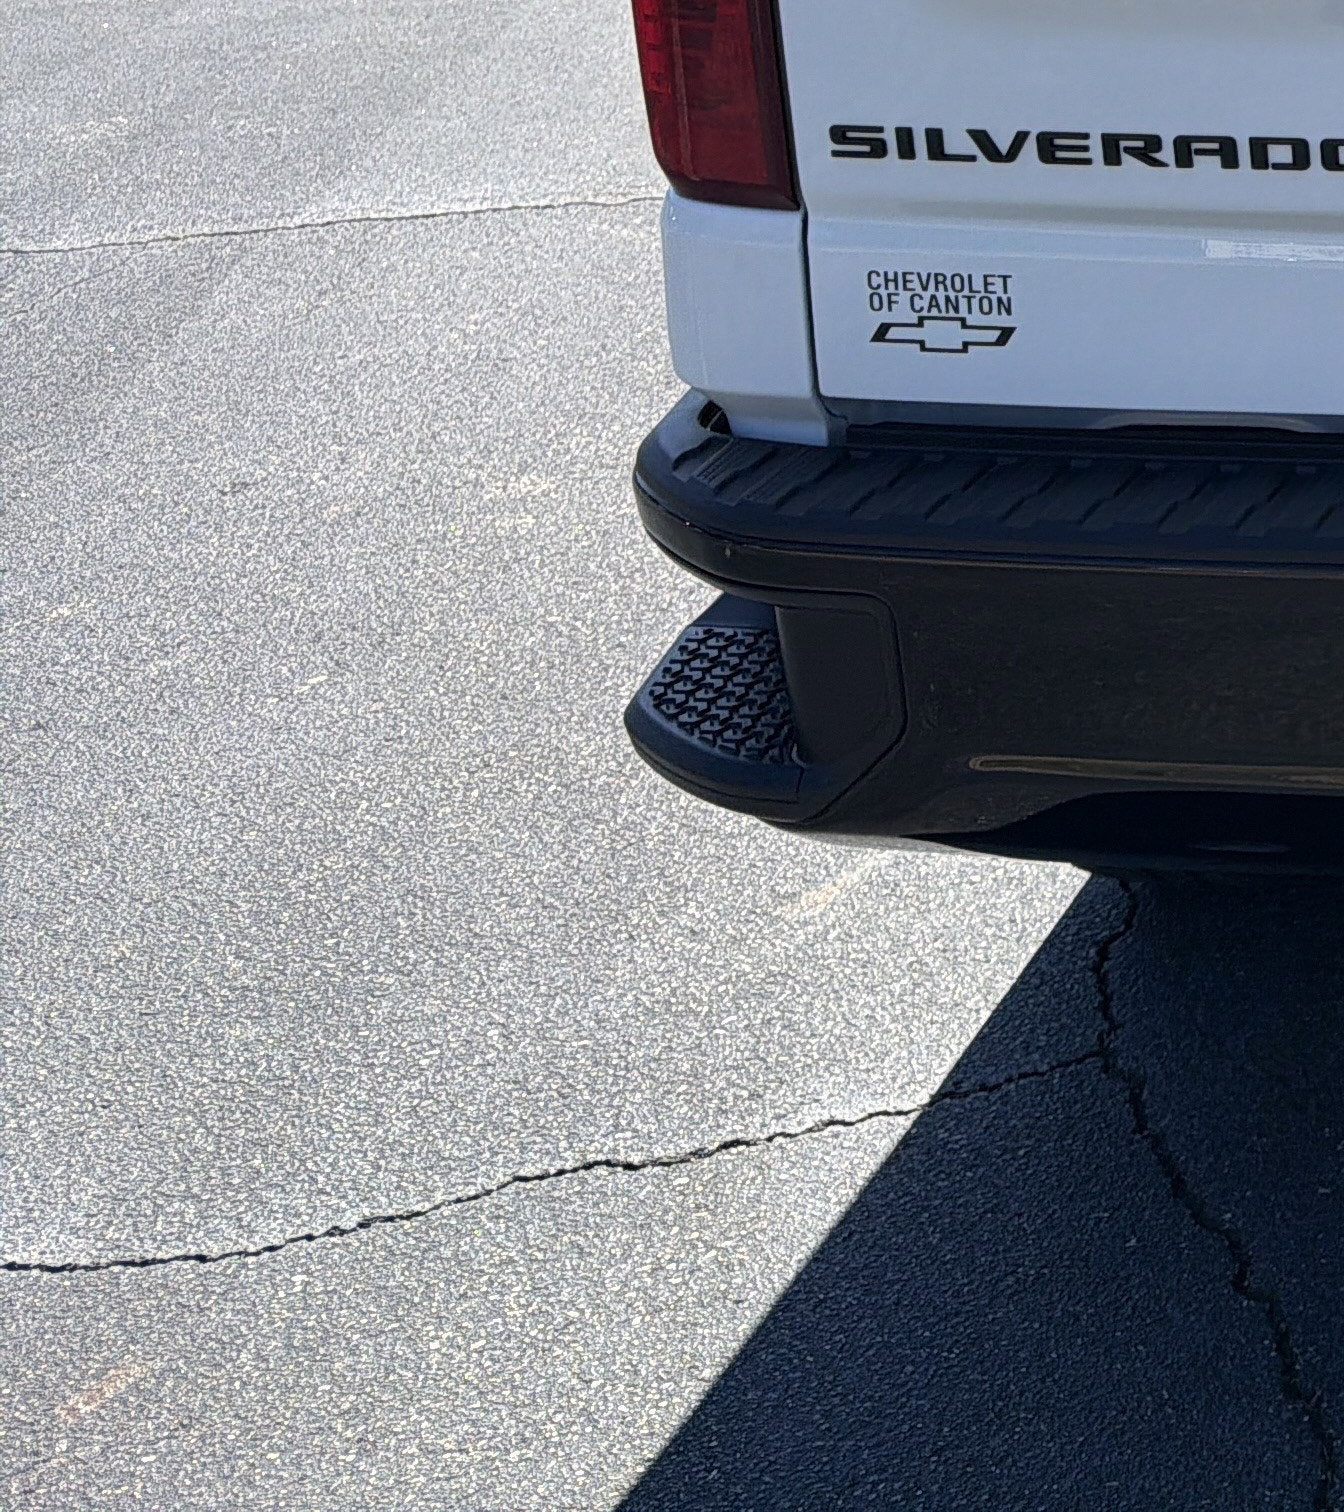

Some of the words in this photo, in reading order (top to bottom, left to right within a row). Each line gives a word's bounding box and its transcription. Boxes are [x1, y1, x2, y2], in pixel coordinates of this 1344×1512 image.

[867, 270, 1013, 295] CHEVROLET
[869, 292, 899, 312] OF
[909, 293, 1013, 316] CANTON
